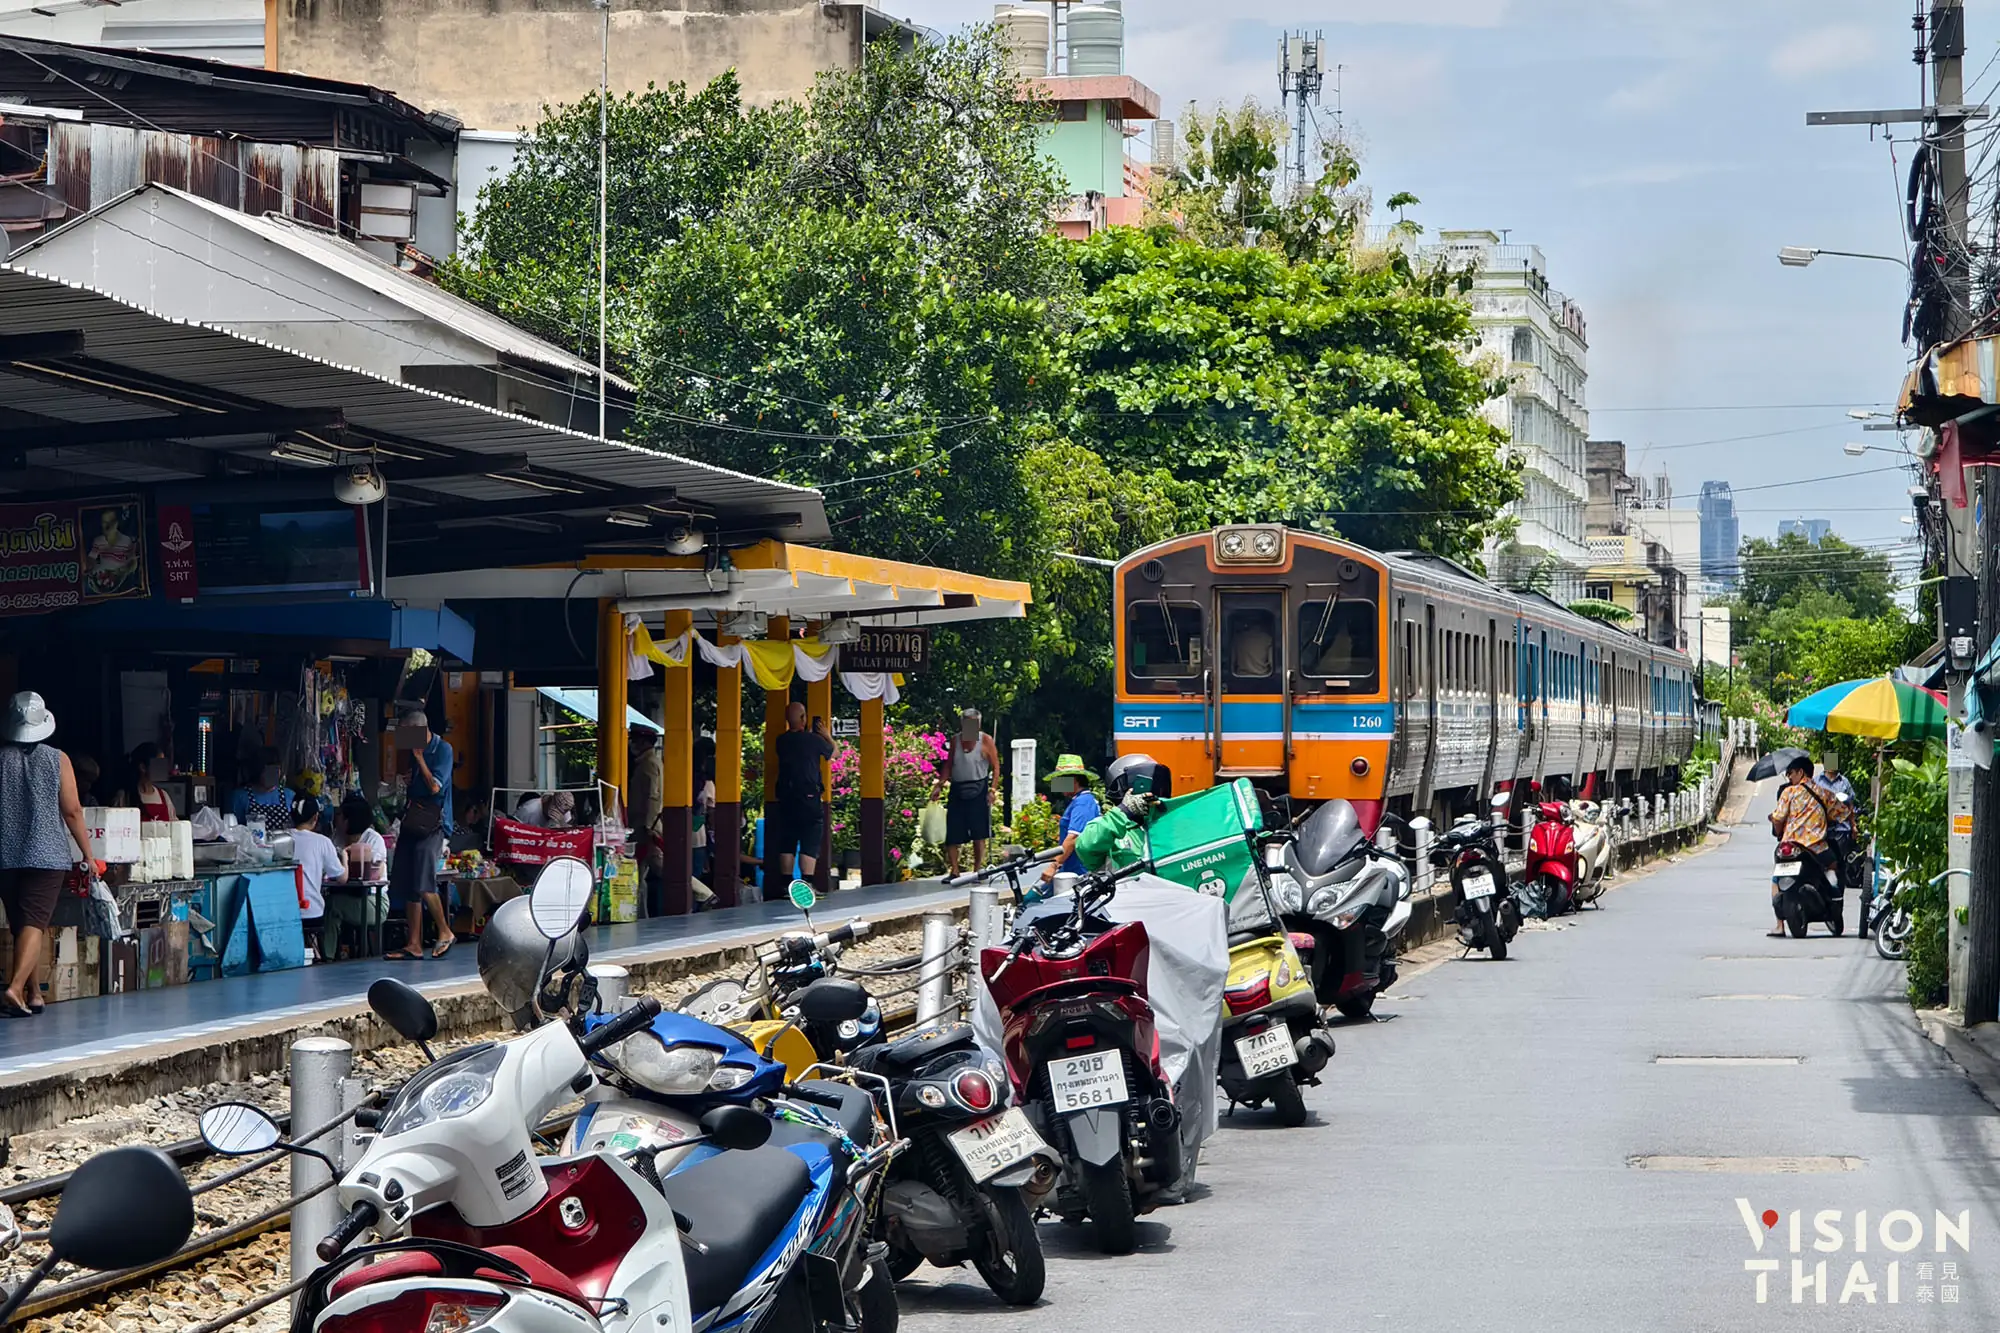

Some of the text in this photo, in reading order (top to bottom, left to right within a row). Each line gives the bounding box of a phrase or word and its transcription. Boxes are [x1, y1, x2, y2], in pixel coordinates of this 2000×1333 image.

[169, 571, 191, 582] SRT
[851, 656, 910, 669] TALAT PHLU
[1123, 716, 1161, 728] SRT
[1352, 715, 1382, 728] 1260
[1248, 1031, 1277, 1049] 7กล
[1252, 1054, 1289, 1075] 2236
[1056, 1072, 1120, 1092] กรุงเทพมหานคร
[1066, 1087, 1114, 1107] 5681
